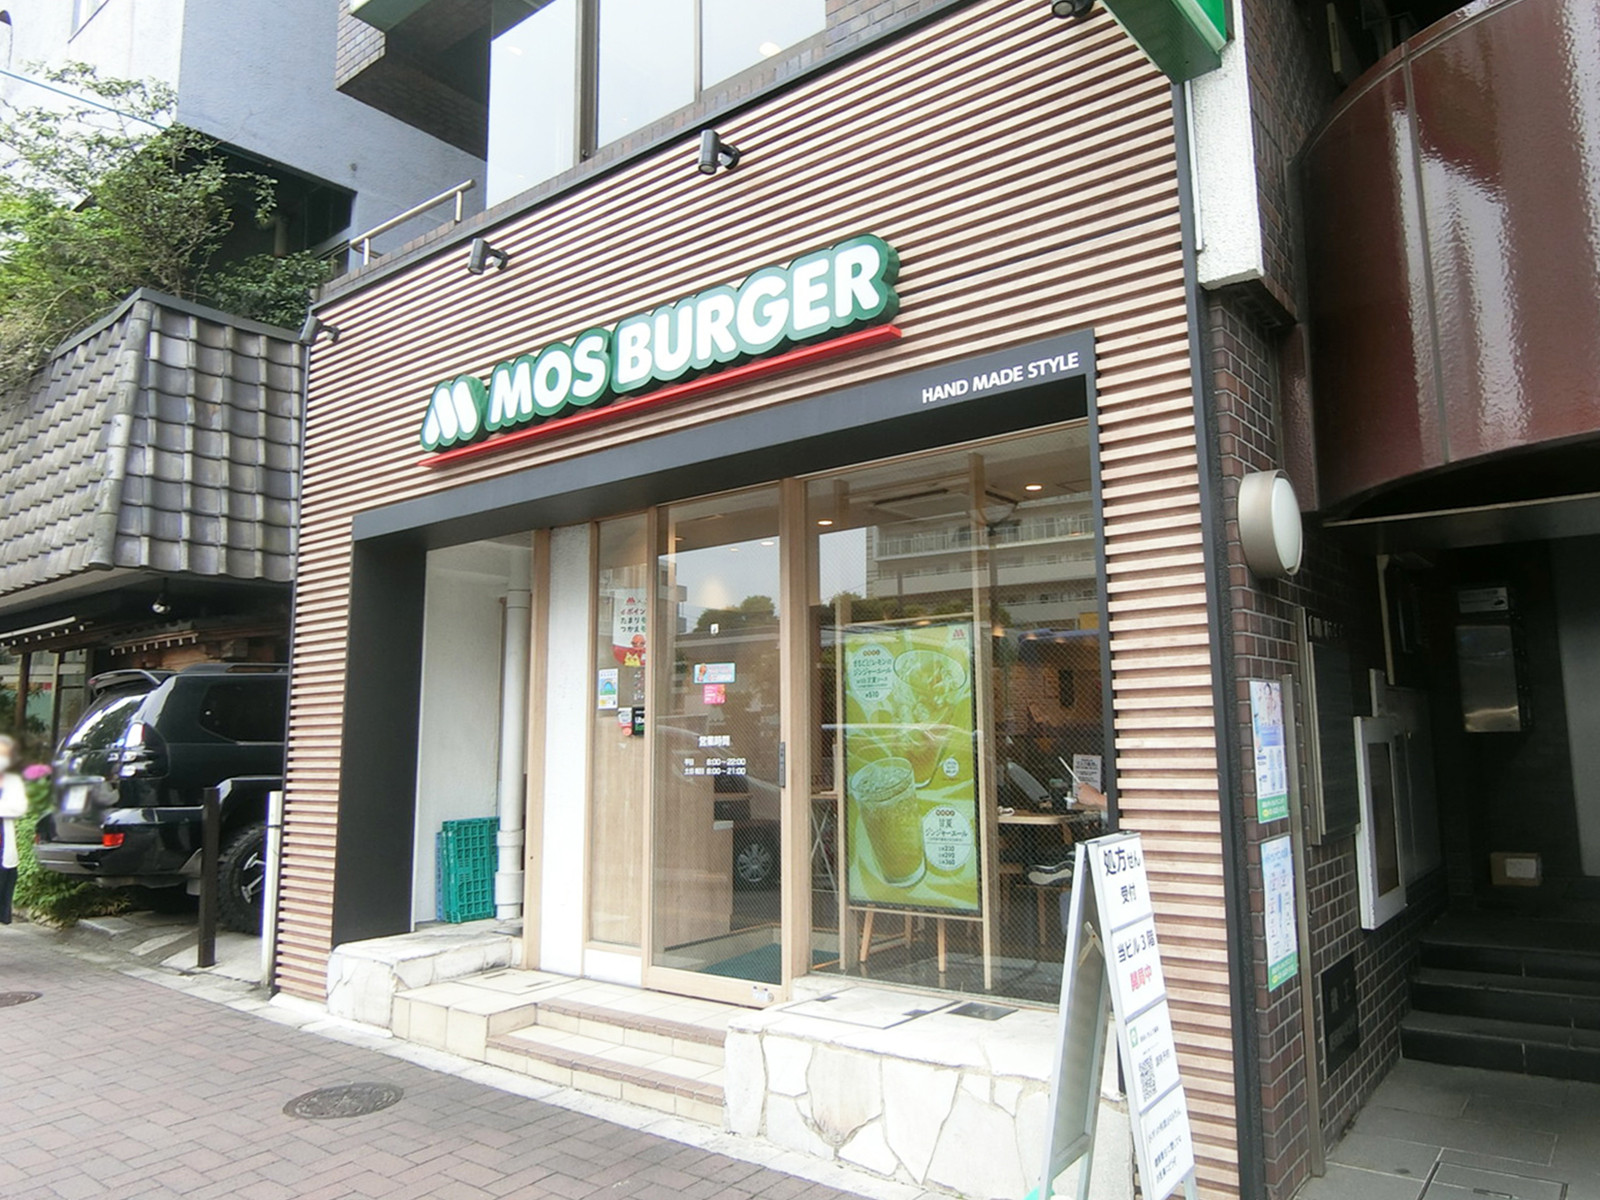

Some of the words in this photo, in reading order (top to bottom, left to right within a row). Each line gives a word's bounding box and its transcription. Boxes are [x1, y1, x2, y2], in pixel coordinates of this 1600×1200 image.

[489, 332, 608, 425] MOS
[616, 243, 881, 385] BURGER
[921, 379, 969, 404] HAND
[972, 365, 1024, 392] MADE
[1027, 352, 1079, 379] STYLE
[1103, 847, 1141, 876] 処方せん
[1120, 882, 1137, 904] 受付
